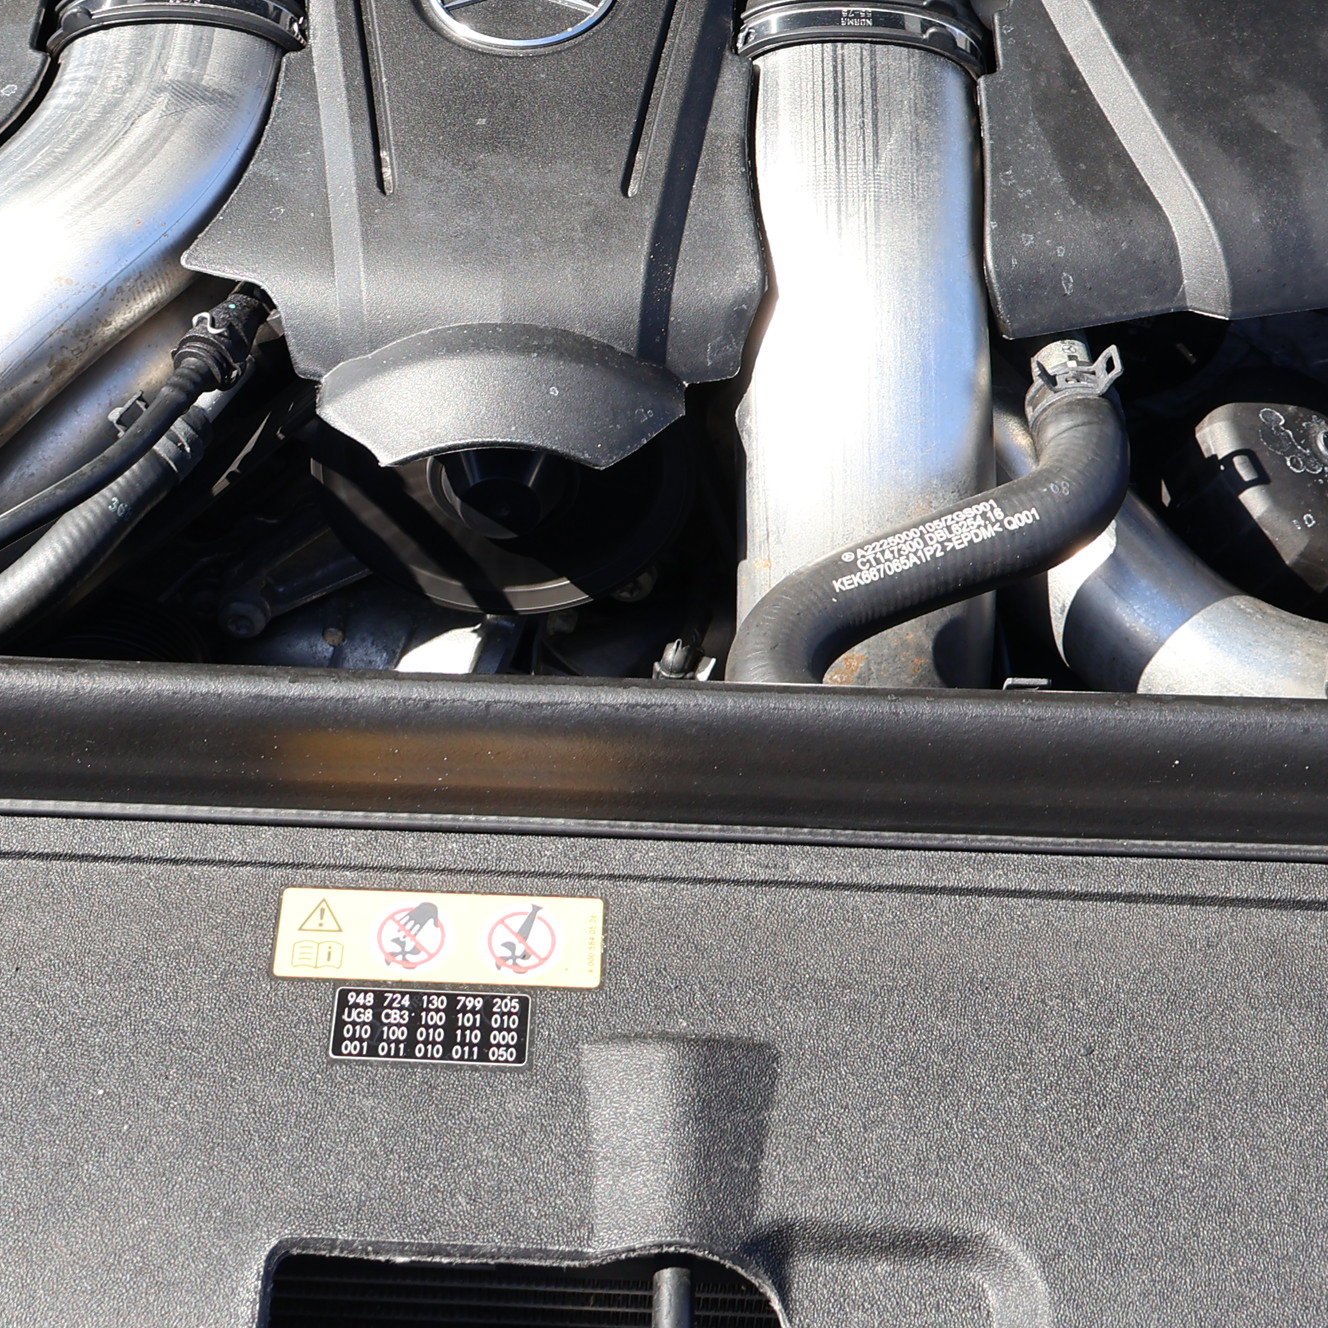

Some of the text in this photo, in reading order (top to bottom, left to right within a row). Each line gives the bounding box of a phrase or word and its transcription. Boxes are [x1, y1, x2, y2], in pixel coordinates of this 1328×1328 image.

[840, 17, 873, 26] NORMA
[1004, 507, 1041, 531] Q001
[856, 508, 1005, 571] CT147300 DBL6254.16
[347, 992, 519, 1012] 948 724 130 799 205
[344, 1008, 519, 1028] UG8 CB3 100 101 010
[344, 1024, 517, 1044] 010 100 010 110 000
[342, 1041, 516, 1061] 001 011 010 011 050
